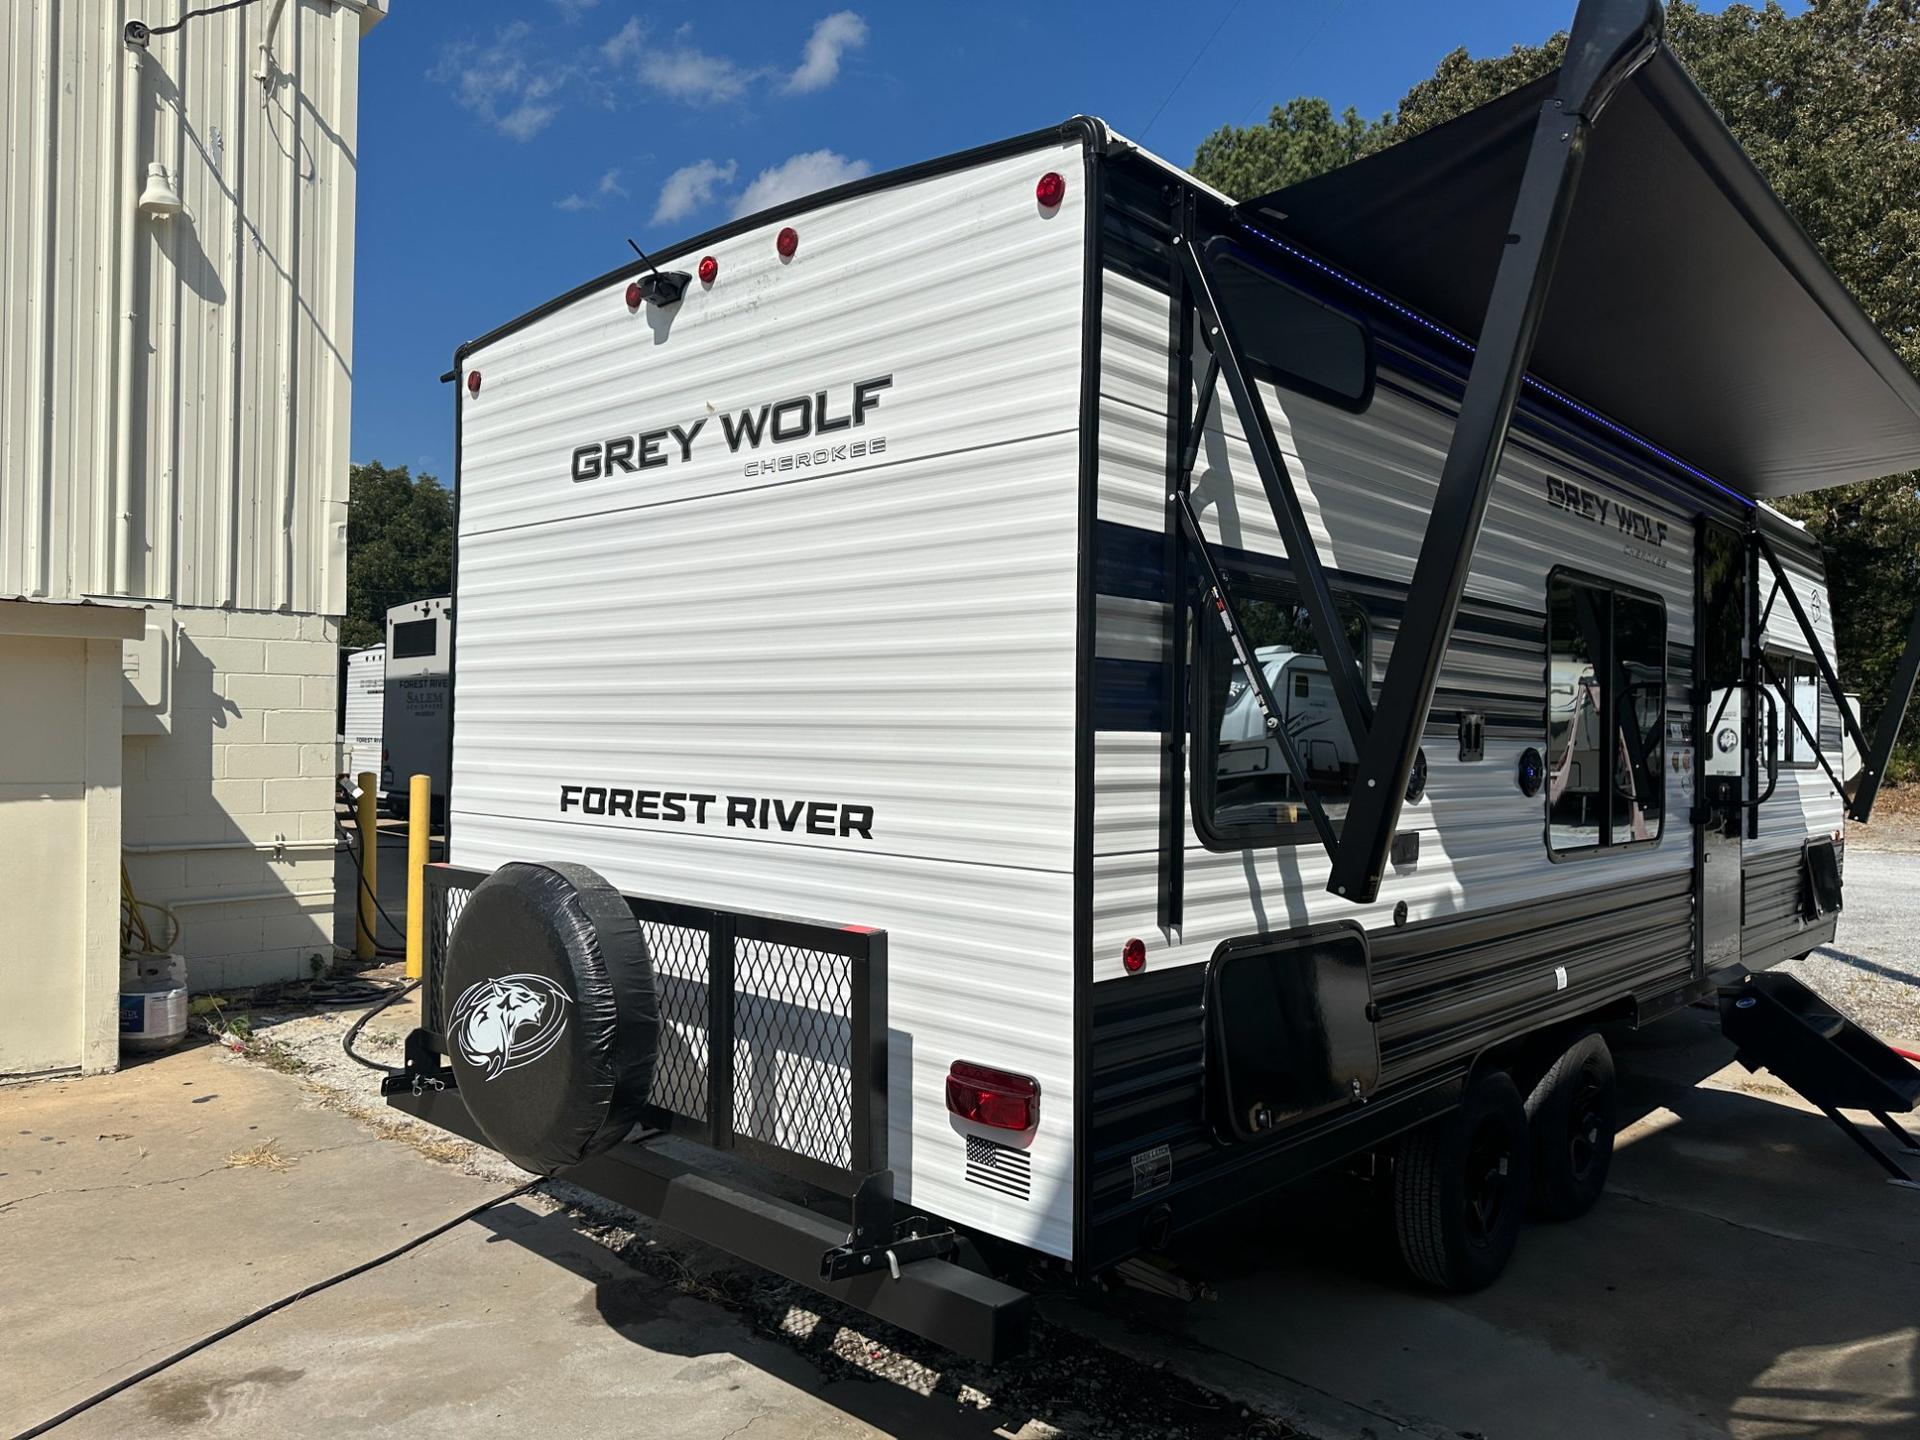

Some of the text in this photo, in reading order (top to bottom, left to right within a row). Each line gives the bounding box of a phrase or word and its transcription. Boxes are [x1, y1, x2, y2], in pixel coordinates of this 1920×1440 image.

[571, 373, 893, 483] GREY WOLF
[745, 437, 887, 477] CHEROKEE
[1546, 475, 1668, 547] GREY WOLF
[400, 679, 449, 688] FOREST RIVE
[560, 785, 874, 840] FOREST RIVER
